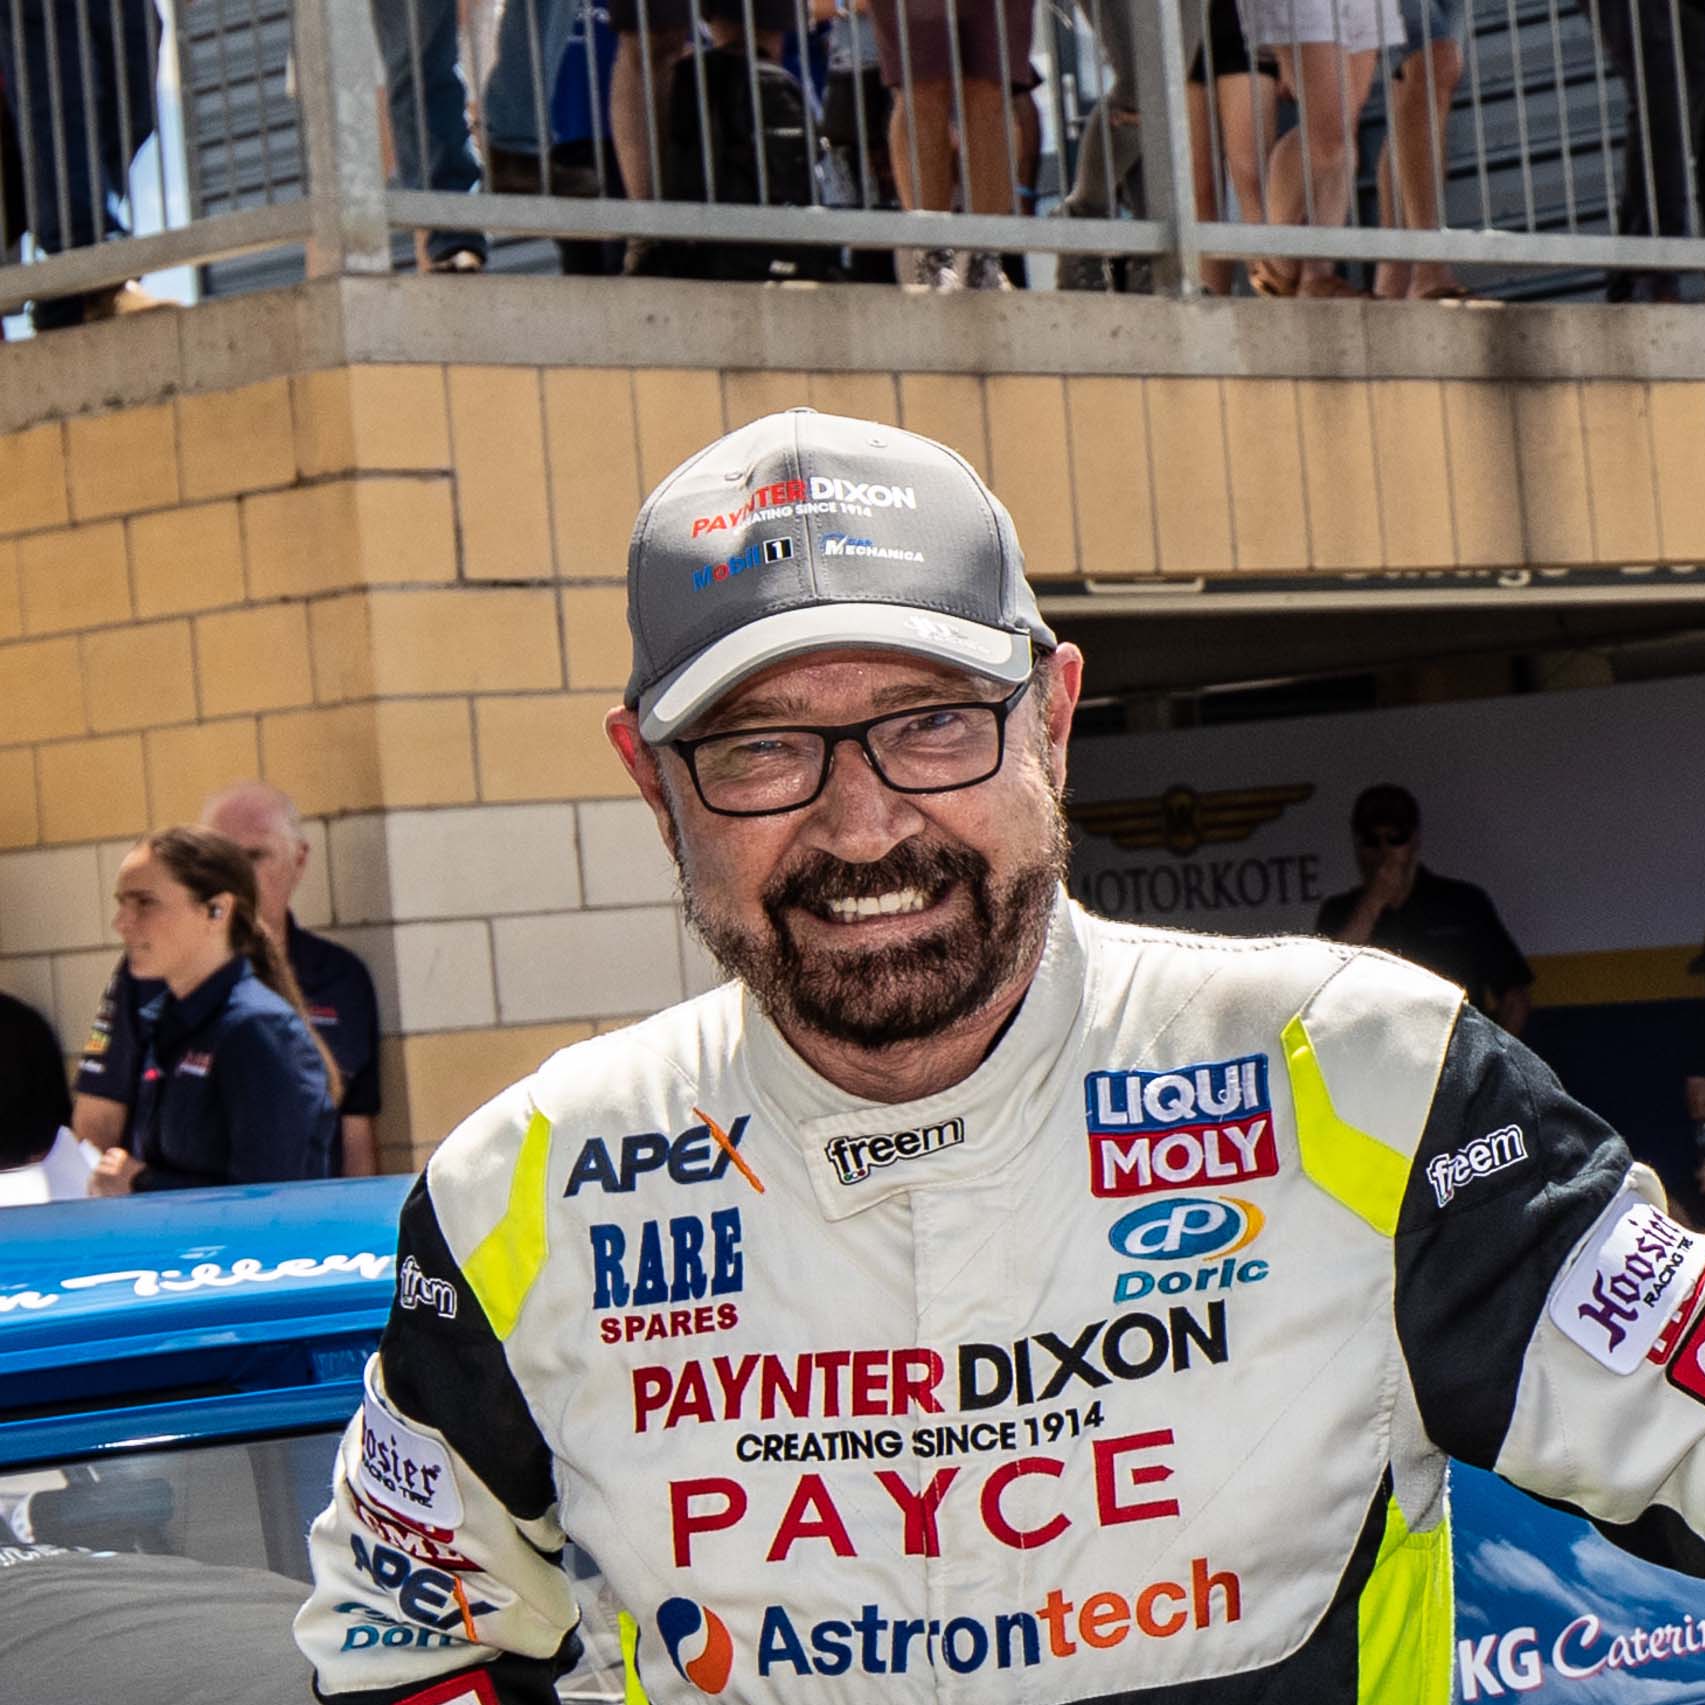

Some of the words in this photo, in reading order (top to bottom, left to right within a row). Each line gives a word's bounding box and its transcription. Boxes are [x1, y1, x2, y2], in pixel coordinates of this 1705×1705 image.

[691, 479, 806, 538] PAYNTER
[809, 477, 917, 510] DIXON
[796, 501, 837, 516] SINCE
[840, 502, 872, 518] 1914
[692, 542, 763, 592] Mobil
[1096, 1060, 1260, 1126] LIQUI
[563, 1107, 765, 1199] APEX
[827, 1117, 964, 1186] freem
[1101, 1119, 1268, 1191] MOLY
[590, 1206, 743, 1310] RARE
[1114, 1258, 1271, 1304] Doric
[1642, 1249, 1685, 1309] RACING
[600, 1302, 739, 1344] SPARES
[632, 1348, 945, 1434] PAYNTER
[957, 1299, 1229, 1412] DIXON
[735, 1427, 903, 1463] CREATING
[911, 1419, 1018, 1457] SINCE
[1024, 1400, 1105, 1448] 1914
[668, 1428, 1181, 1569] PAYCE
[756, 1557, 1242, 1678] Astrontech
[1457, 1625, 1543, 1701] KG
